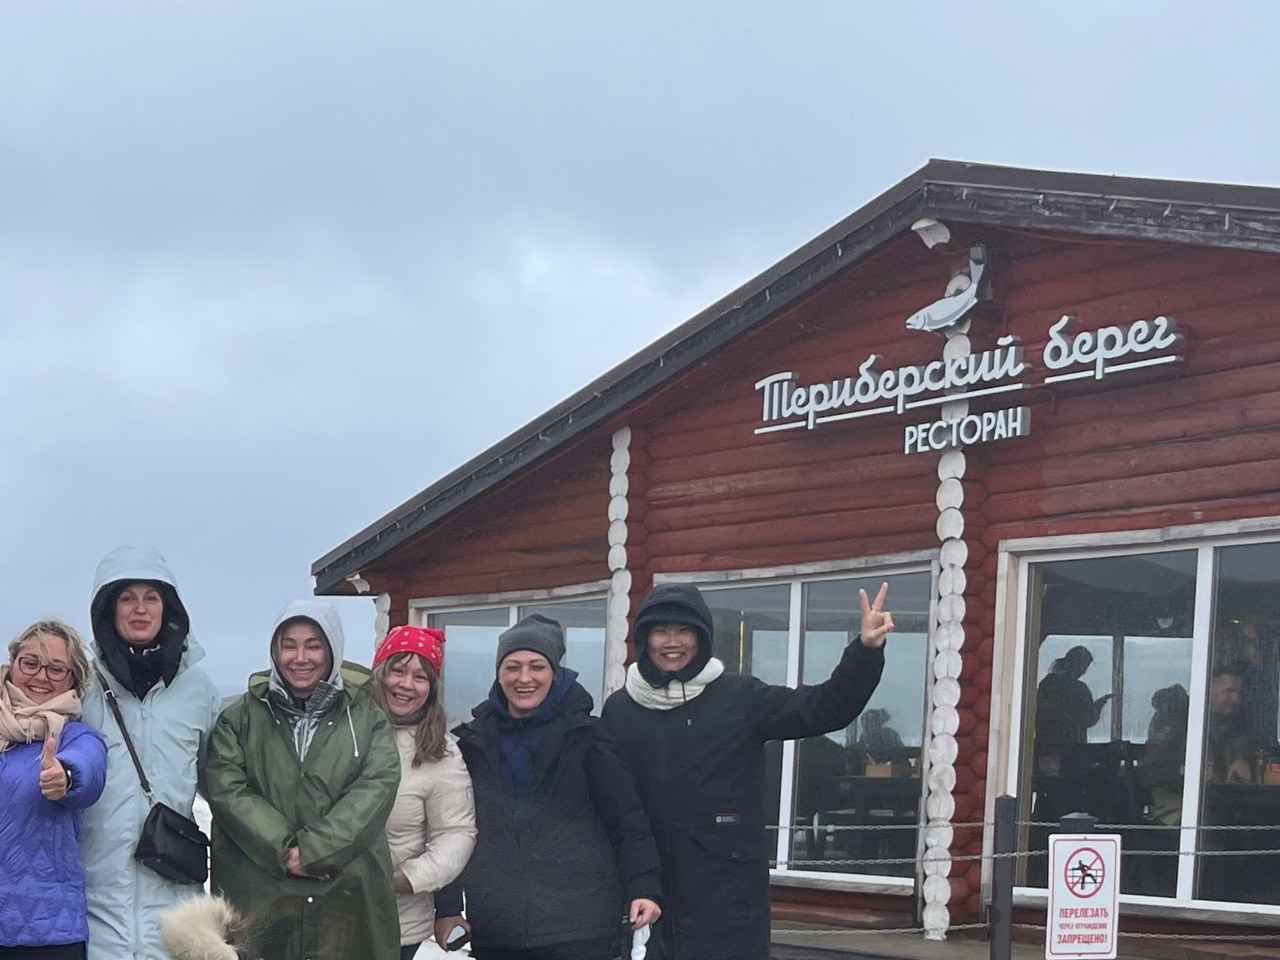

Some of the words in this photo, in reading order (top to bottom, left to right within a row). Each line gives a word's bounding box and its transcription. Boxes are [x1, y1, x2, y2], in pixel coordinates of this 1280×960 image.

[755, 336, 1024, 430] Териберский
[1044, 315, 1177, 379] берег
[904, 406, 1023, 454] РЕСТОРАН
[1059, 908, 1109, 918] ПЕРЕЛЕЗАТЬ
[1056, 934, 1108, 945] ЗАПРЕЩЕНО!
